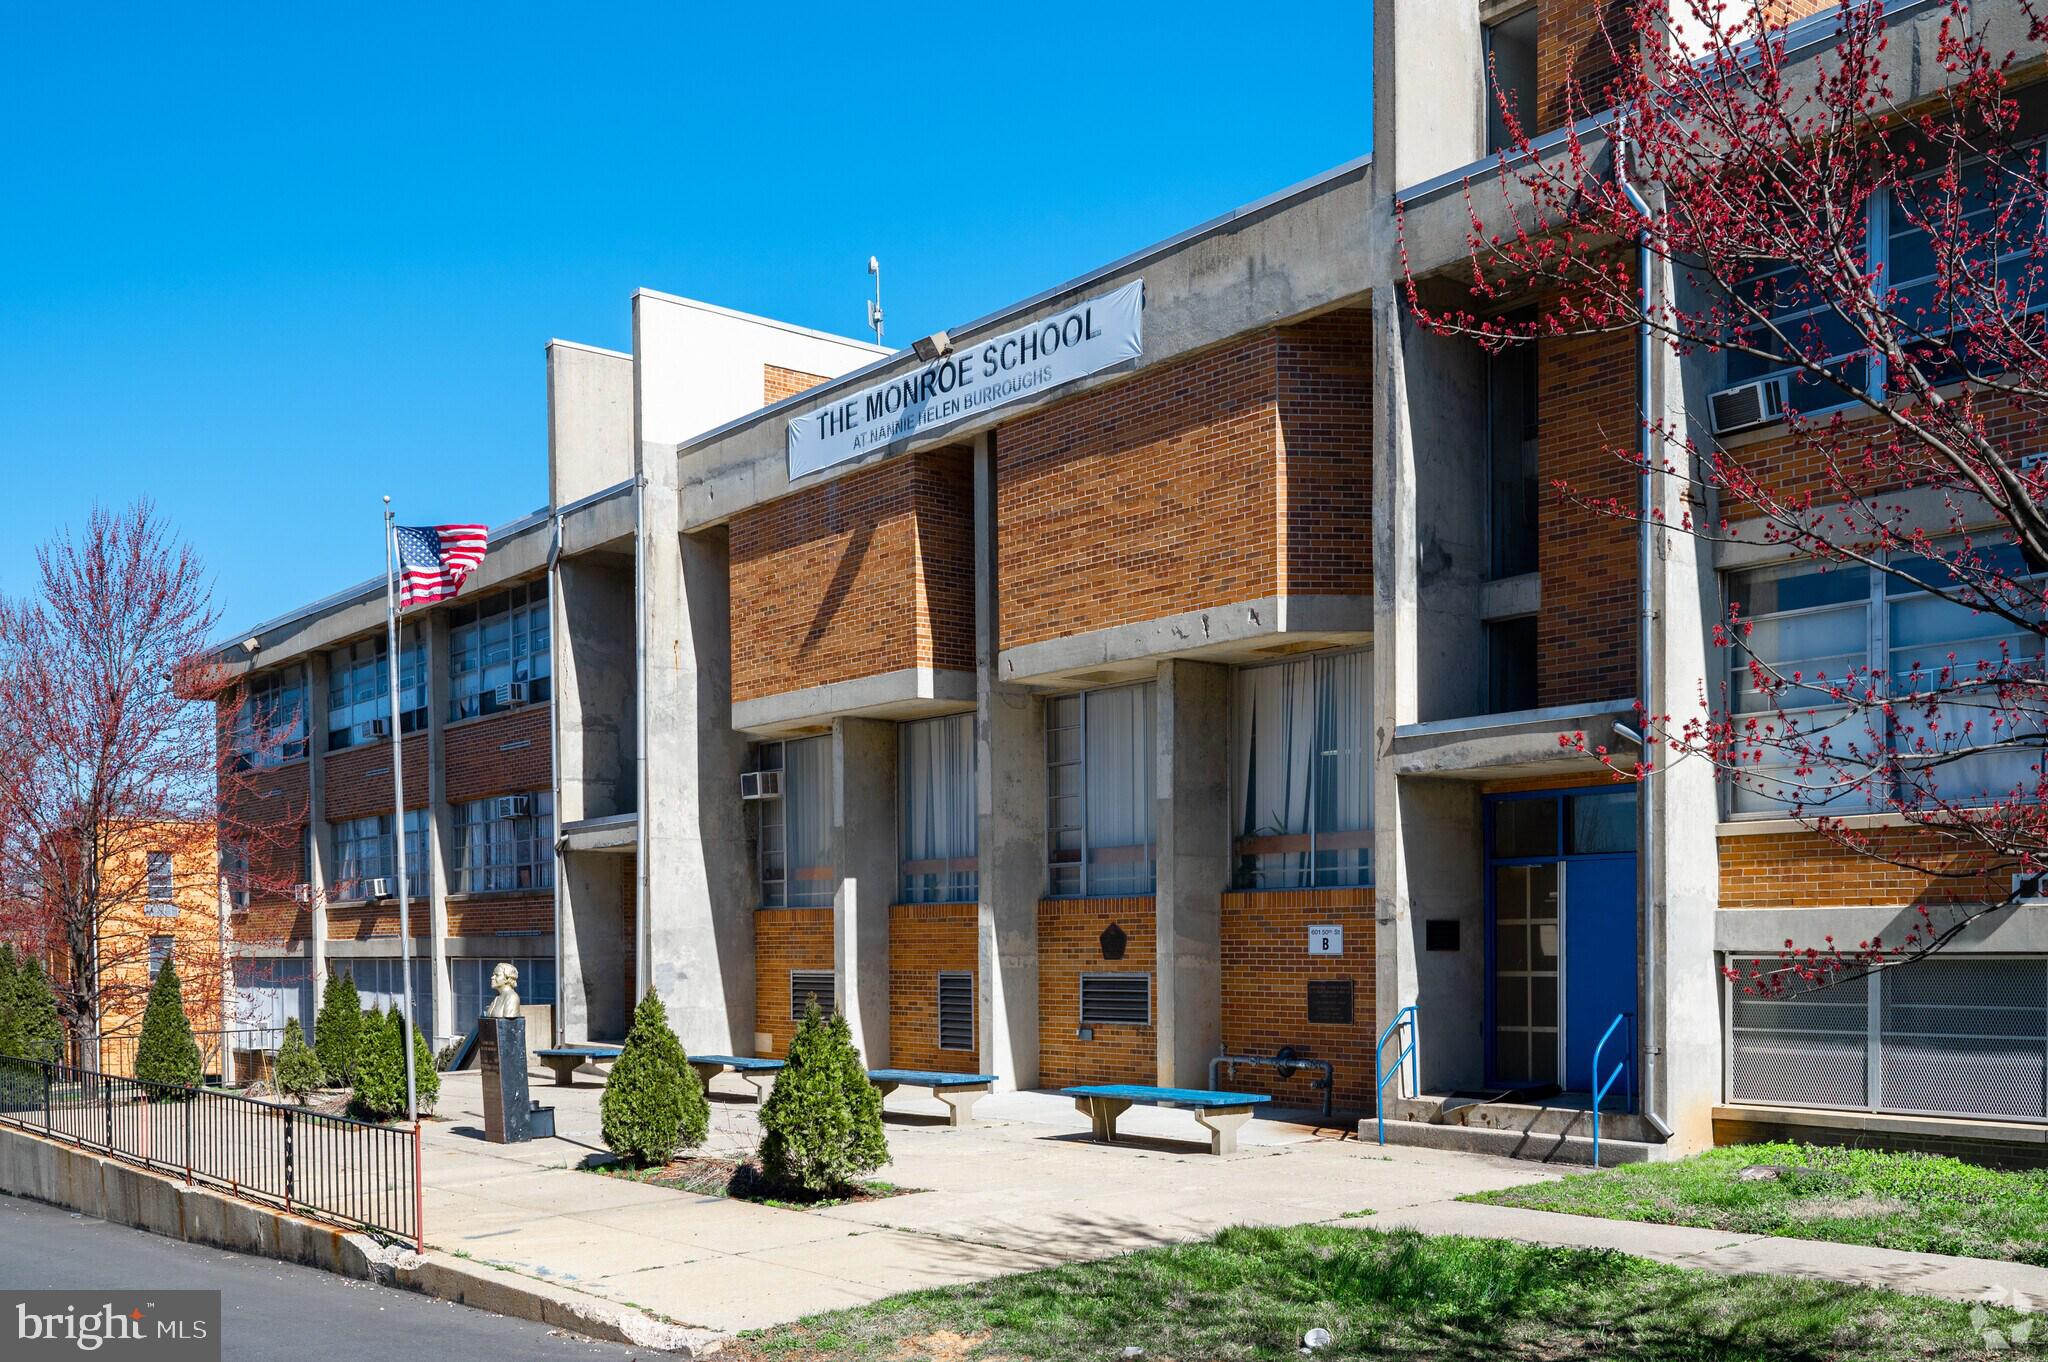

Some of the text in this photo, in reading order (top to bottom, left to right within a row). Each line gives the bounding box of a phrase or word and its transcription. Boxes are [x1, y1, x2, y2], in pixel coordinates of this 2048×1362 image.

[816, 307, 1101, 440] THE MONROE SCHOOL
[853, 365, 1052, 449] AT NANNIE HELEN BURROUGHS
[1322, 937, 1329, 950] B
